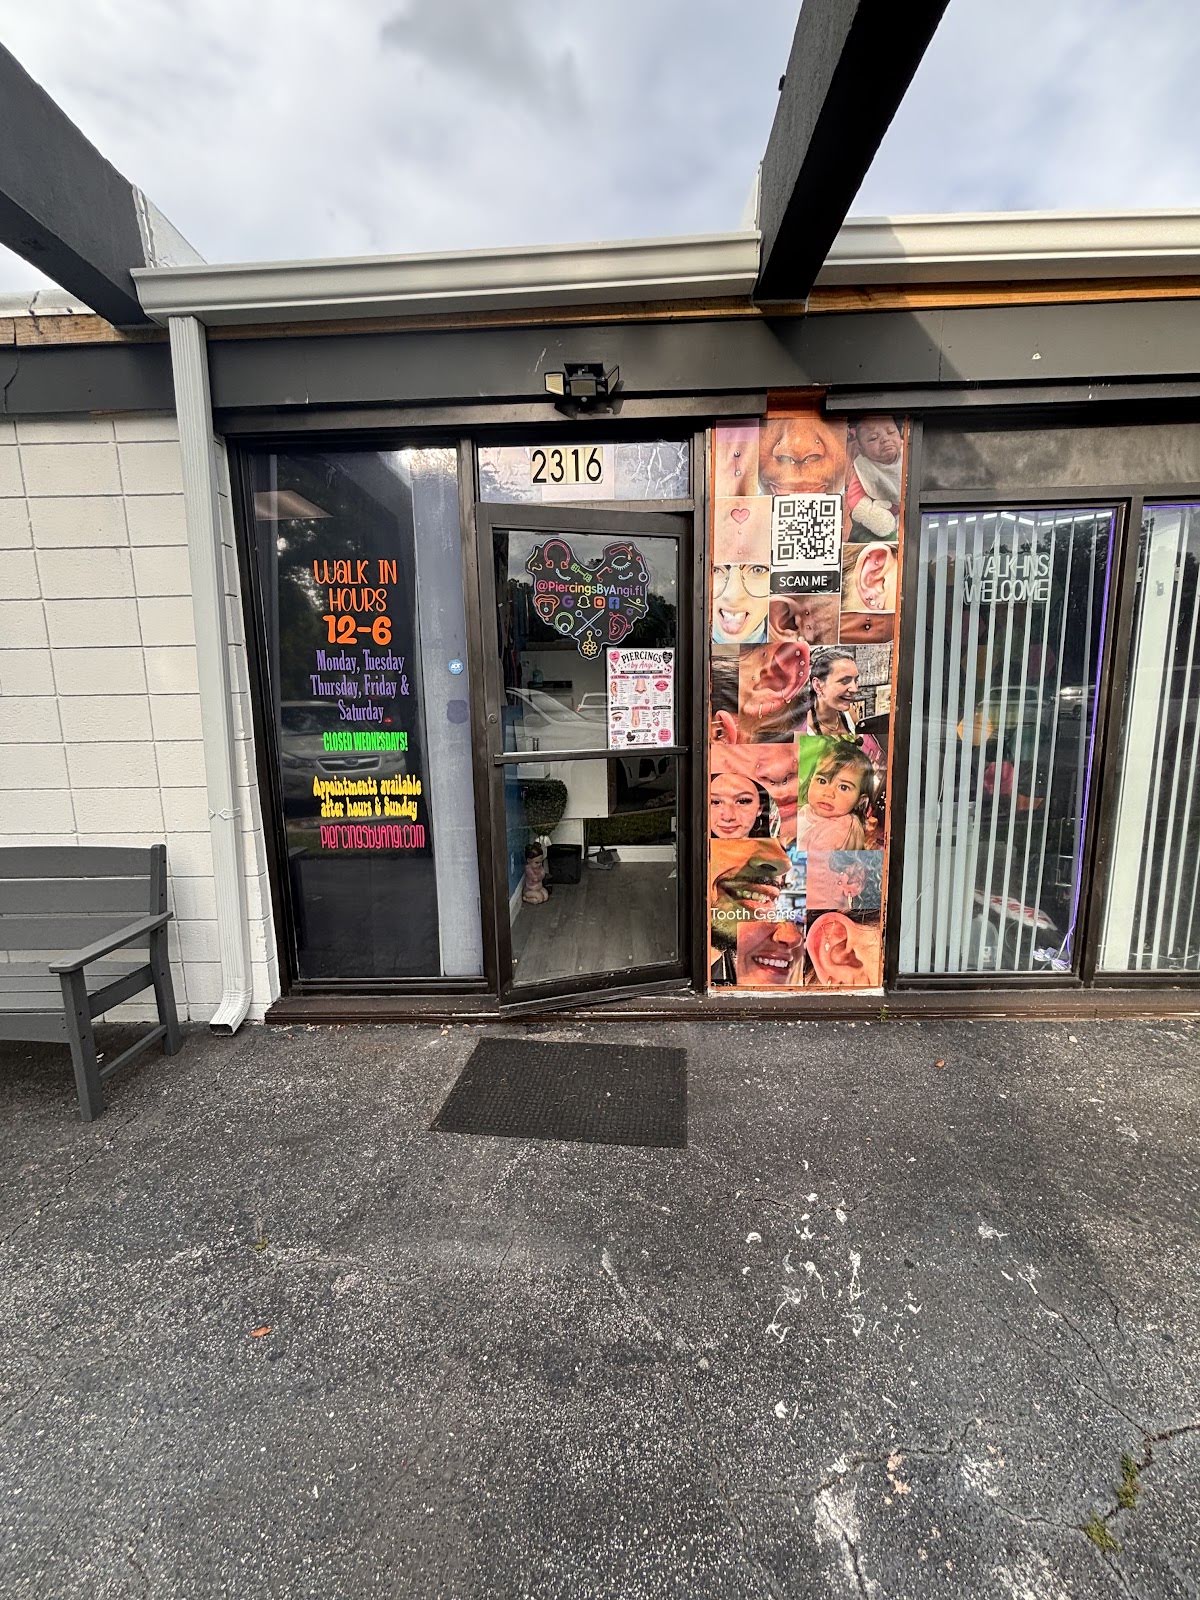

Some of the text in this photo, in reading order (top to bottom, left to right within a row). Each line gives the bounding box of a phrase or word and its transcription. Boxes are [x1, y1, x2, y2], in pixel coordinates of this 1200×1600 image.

[531, 448, 602, 483] 2316
[313, 560, 397, 585] WALK IN
[779, 576, 828, 587] SCAN ME
[328, 588, 387, 612] HOURS
[536, 580, 644, 597] @PiercingsByAngi.fl
[965, 579, 1049, 602] WELCOME
[322, 614, 392, 645] 12-6
[316, 649, 405, 673] Monday, Tuesday
[621, 651, 662, 664] PIERCINGS
[310, 674, 410, 698] Thursday, Friday &
[337, 699, 384, 723] Saturday
[322, 731, 409, 751] CLOSED WEDNESDAYS!
[313, 774, 422, 800] Appointments available
[320, 796, 418, 821] after hours & Sunday
[710, 908, 796, 920] Tooth Gems
